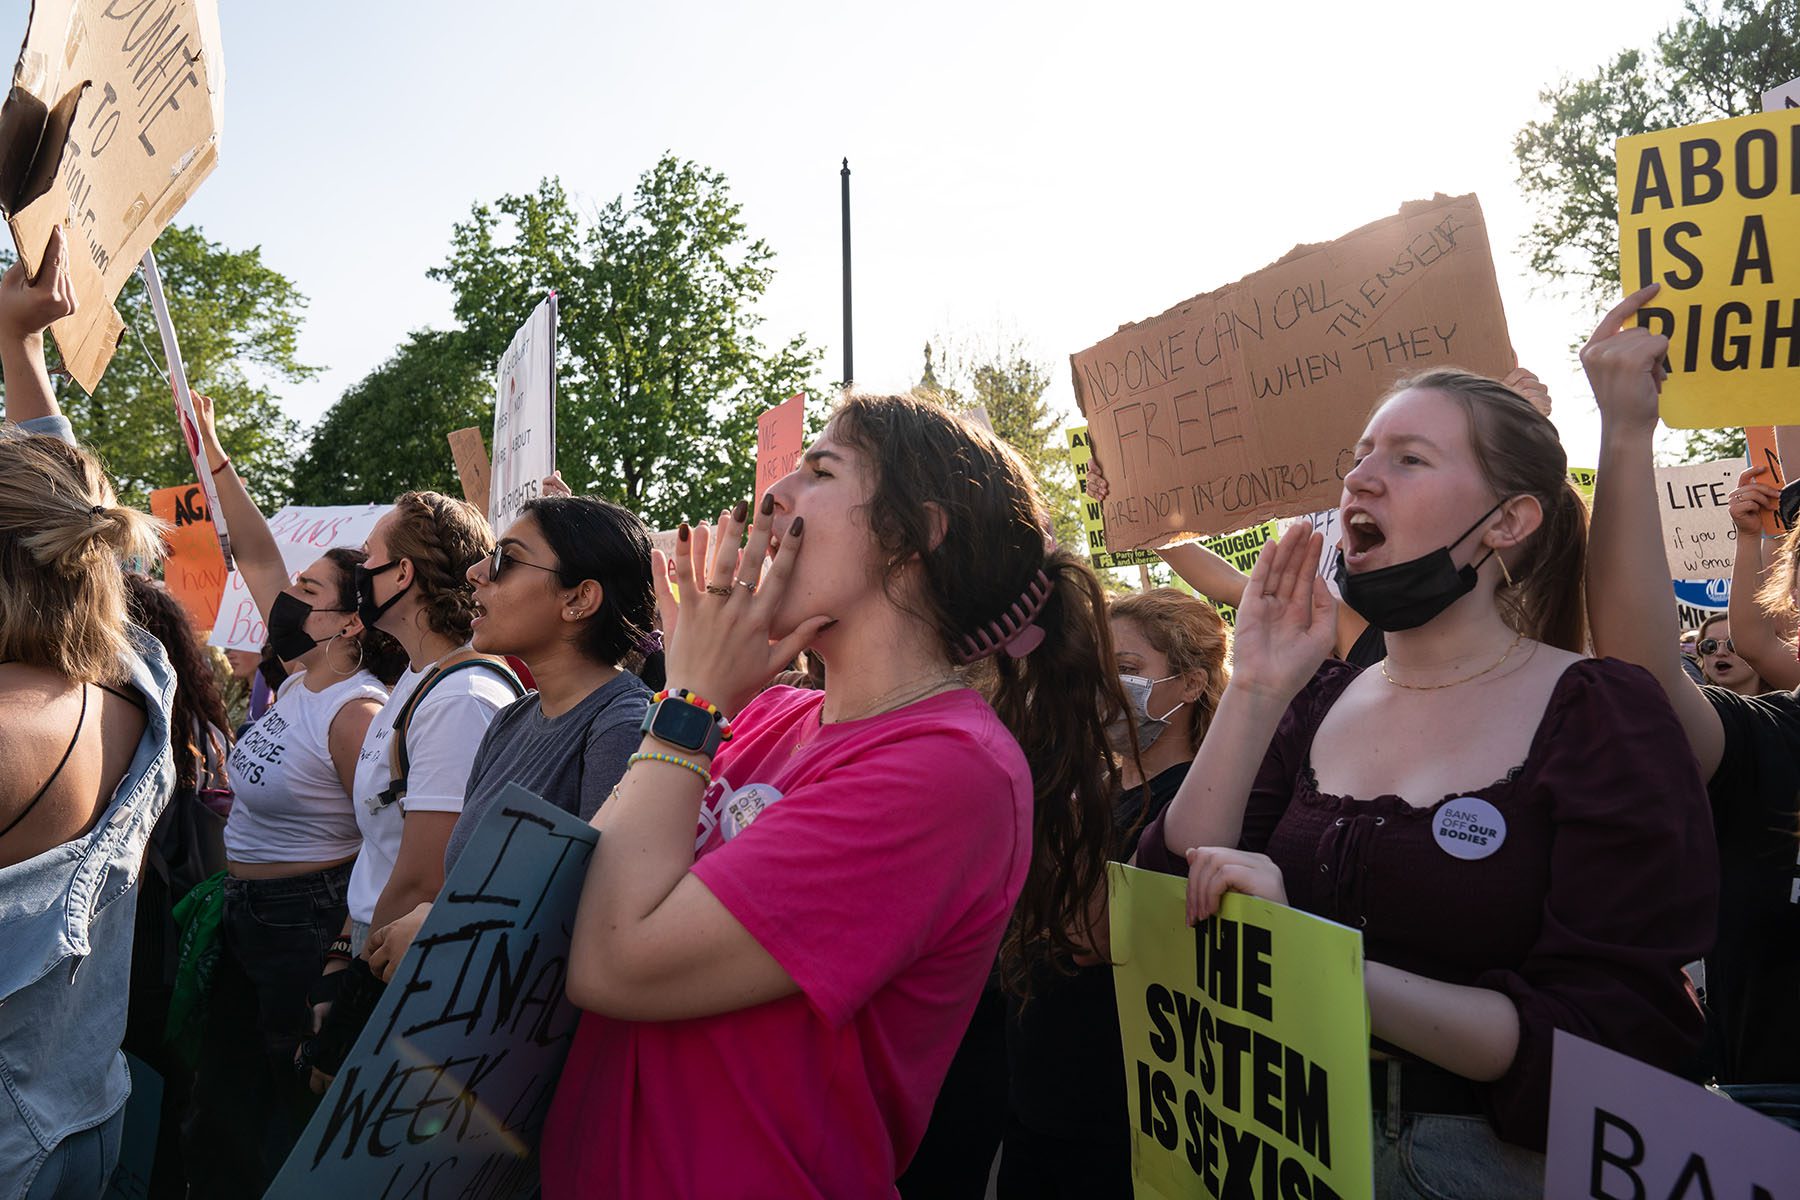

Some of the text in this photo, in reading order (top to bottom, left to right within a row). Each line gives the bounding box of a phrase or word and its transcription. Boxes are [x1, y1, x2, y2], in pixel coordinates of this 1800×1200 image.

[101, 0, 199, 157] ONATE
[87, 81, 121, 158] TO
[1637, 214, 1775, 291] IS A
[1124, 330, 1184, 390] ONE
[1195, 299, 1265, 367] CAN
[1273, 279, 1344, 331] CALL
[762, 421, 777, 452] WE
[1113, 322, 1458, 480] FREE WHEN THEY
[512, 428, 531, 452] ABOUT
[175, 486, 211, 527] AG
[1106, 496, 1141, 532] ARE
[1144, 486, 1185, 524] NOT
[1192, 480, 1214, 516] IN
[1222, 459, 1329, 512] CONTROL
[1673, 526, 1685, 550] if
[1691, 531, 1716, 559] you
[245, 730, 286, 765] CHOICE.
[1439, 827, 1489, 846] BODIES
[1442, 817, 1498, 838] OFF OUR
[1444, 808, 1478, 823] BANS
[1191, 914, 1273, 1022] THE
[1136, 1059, 1179, 1152] IS
[1145, 983, 1332, 1171] SYSTEM
